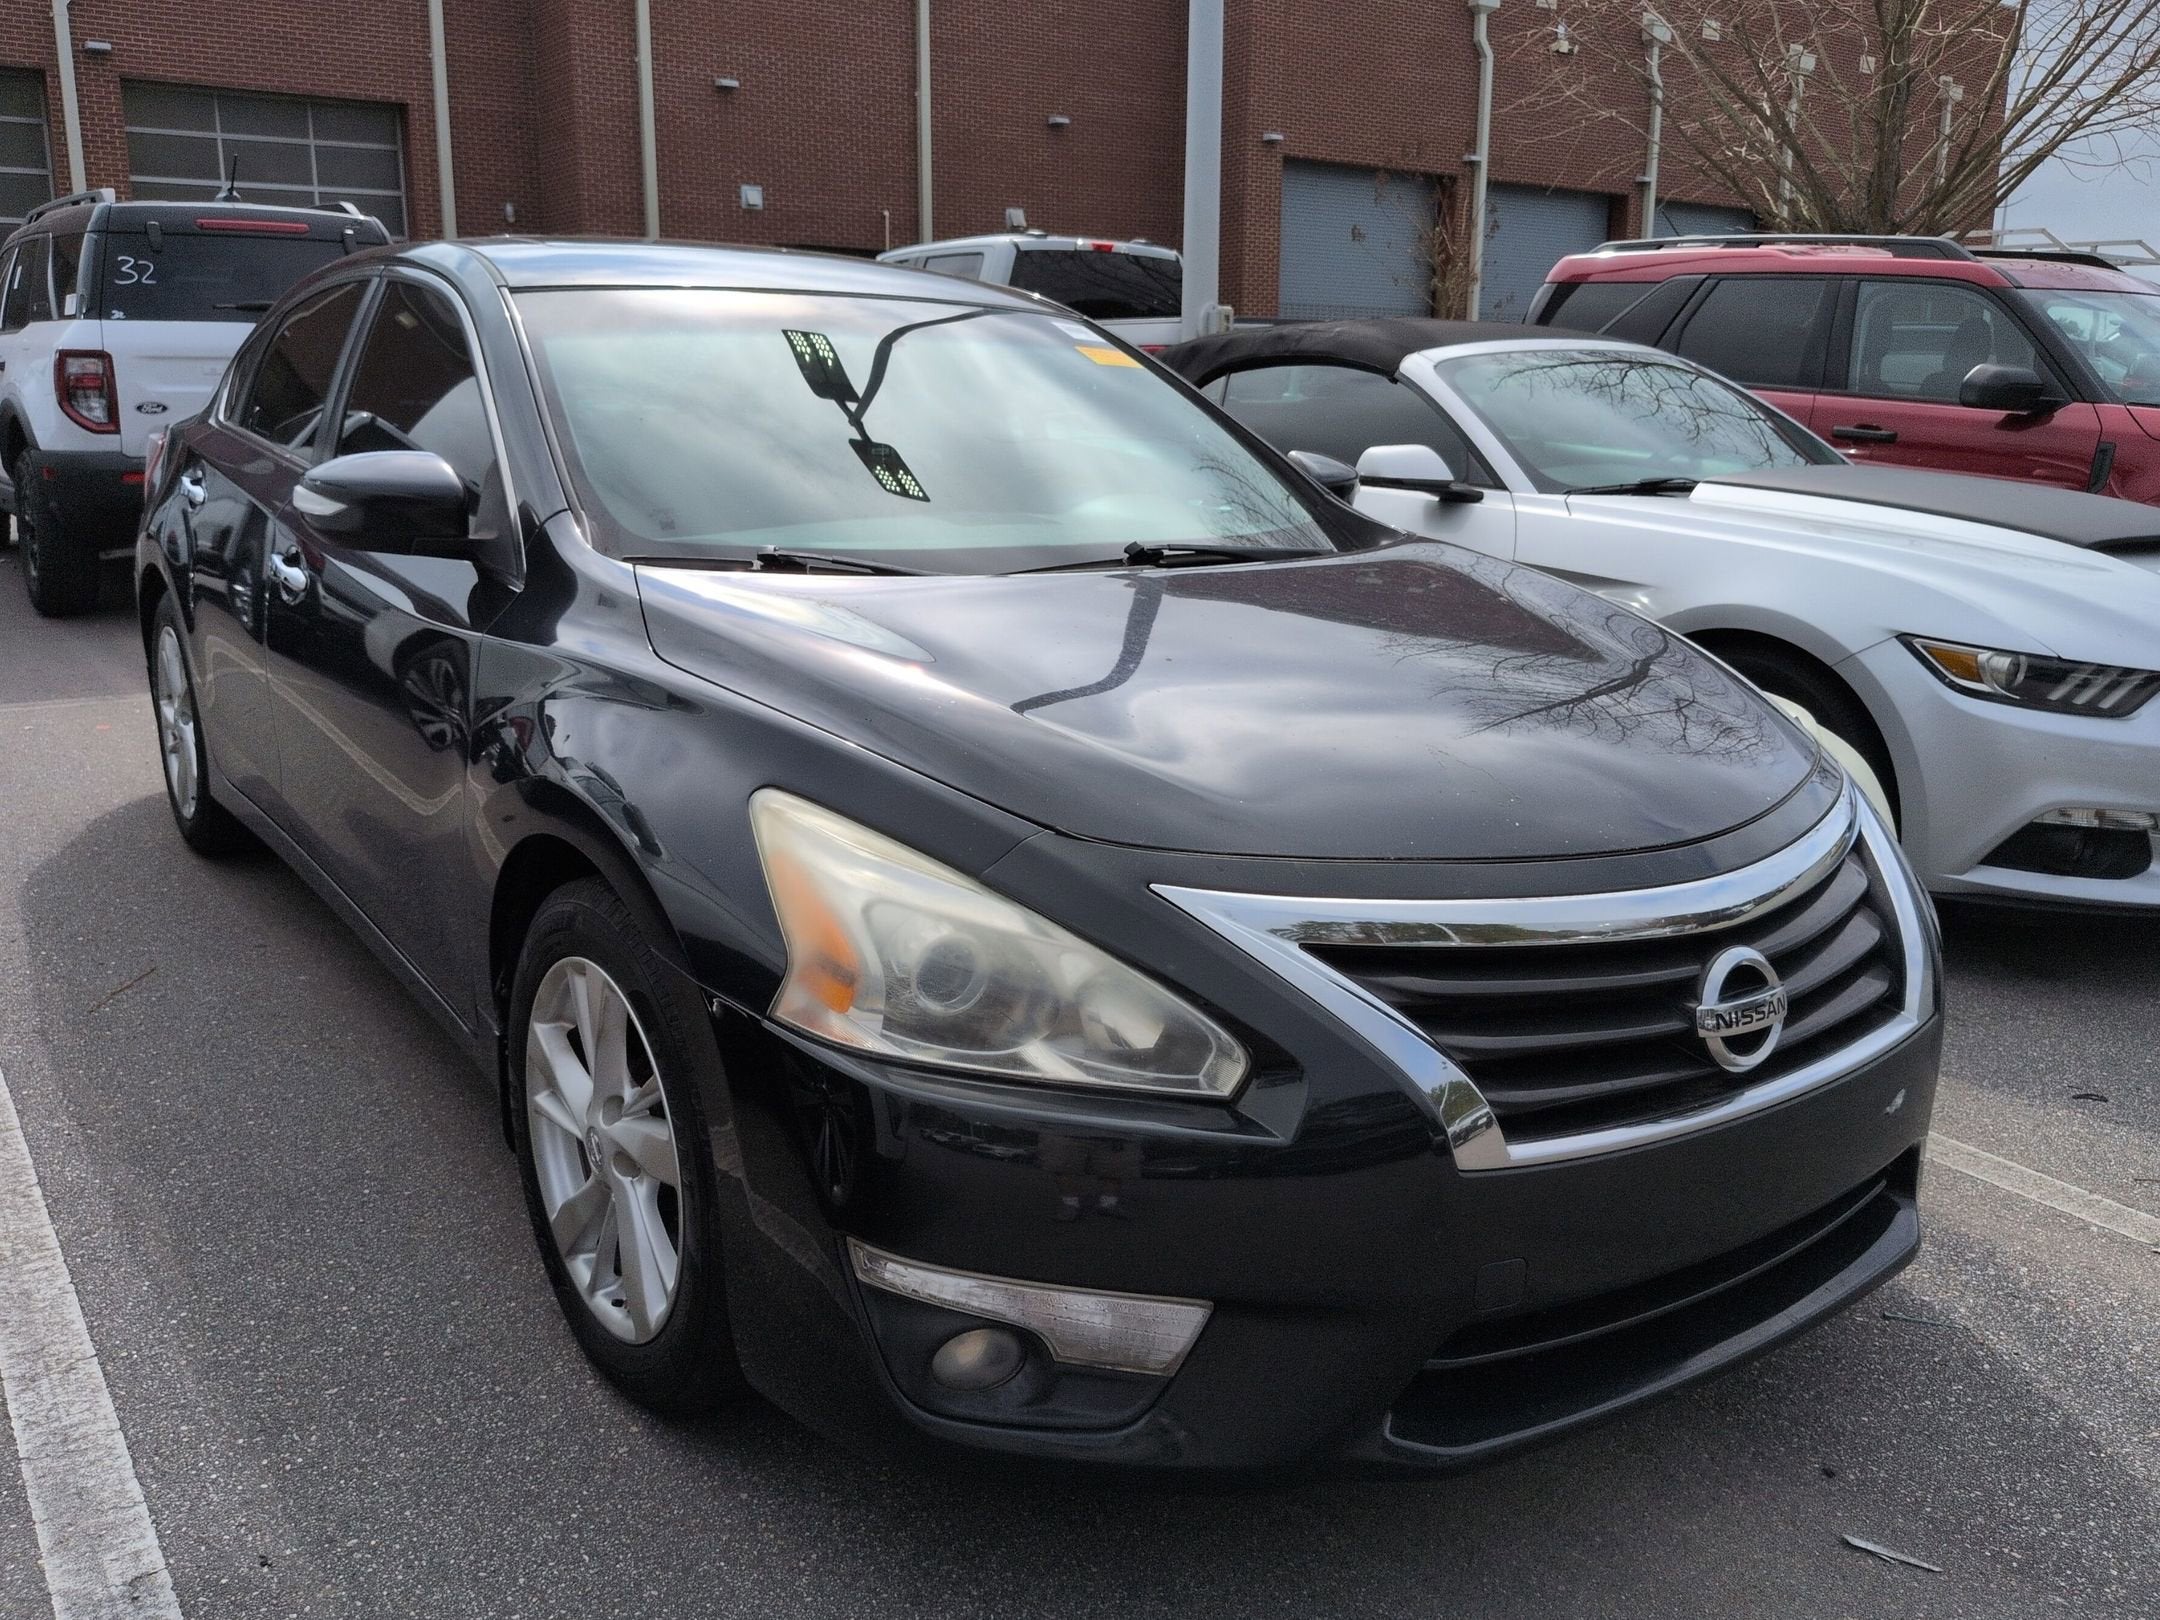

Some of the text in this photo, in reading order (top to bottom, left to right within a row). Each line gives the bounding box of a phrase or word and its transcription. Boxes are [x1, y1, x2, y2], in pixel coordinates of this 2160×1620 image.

[114, 255, 157, 285] 32
[140, 403, 164, 413] Ford
[1715, 994, 1786, 1030] NISSAN
